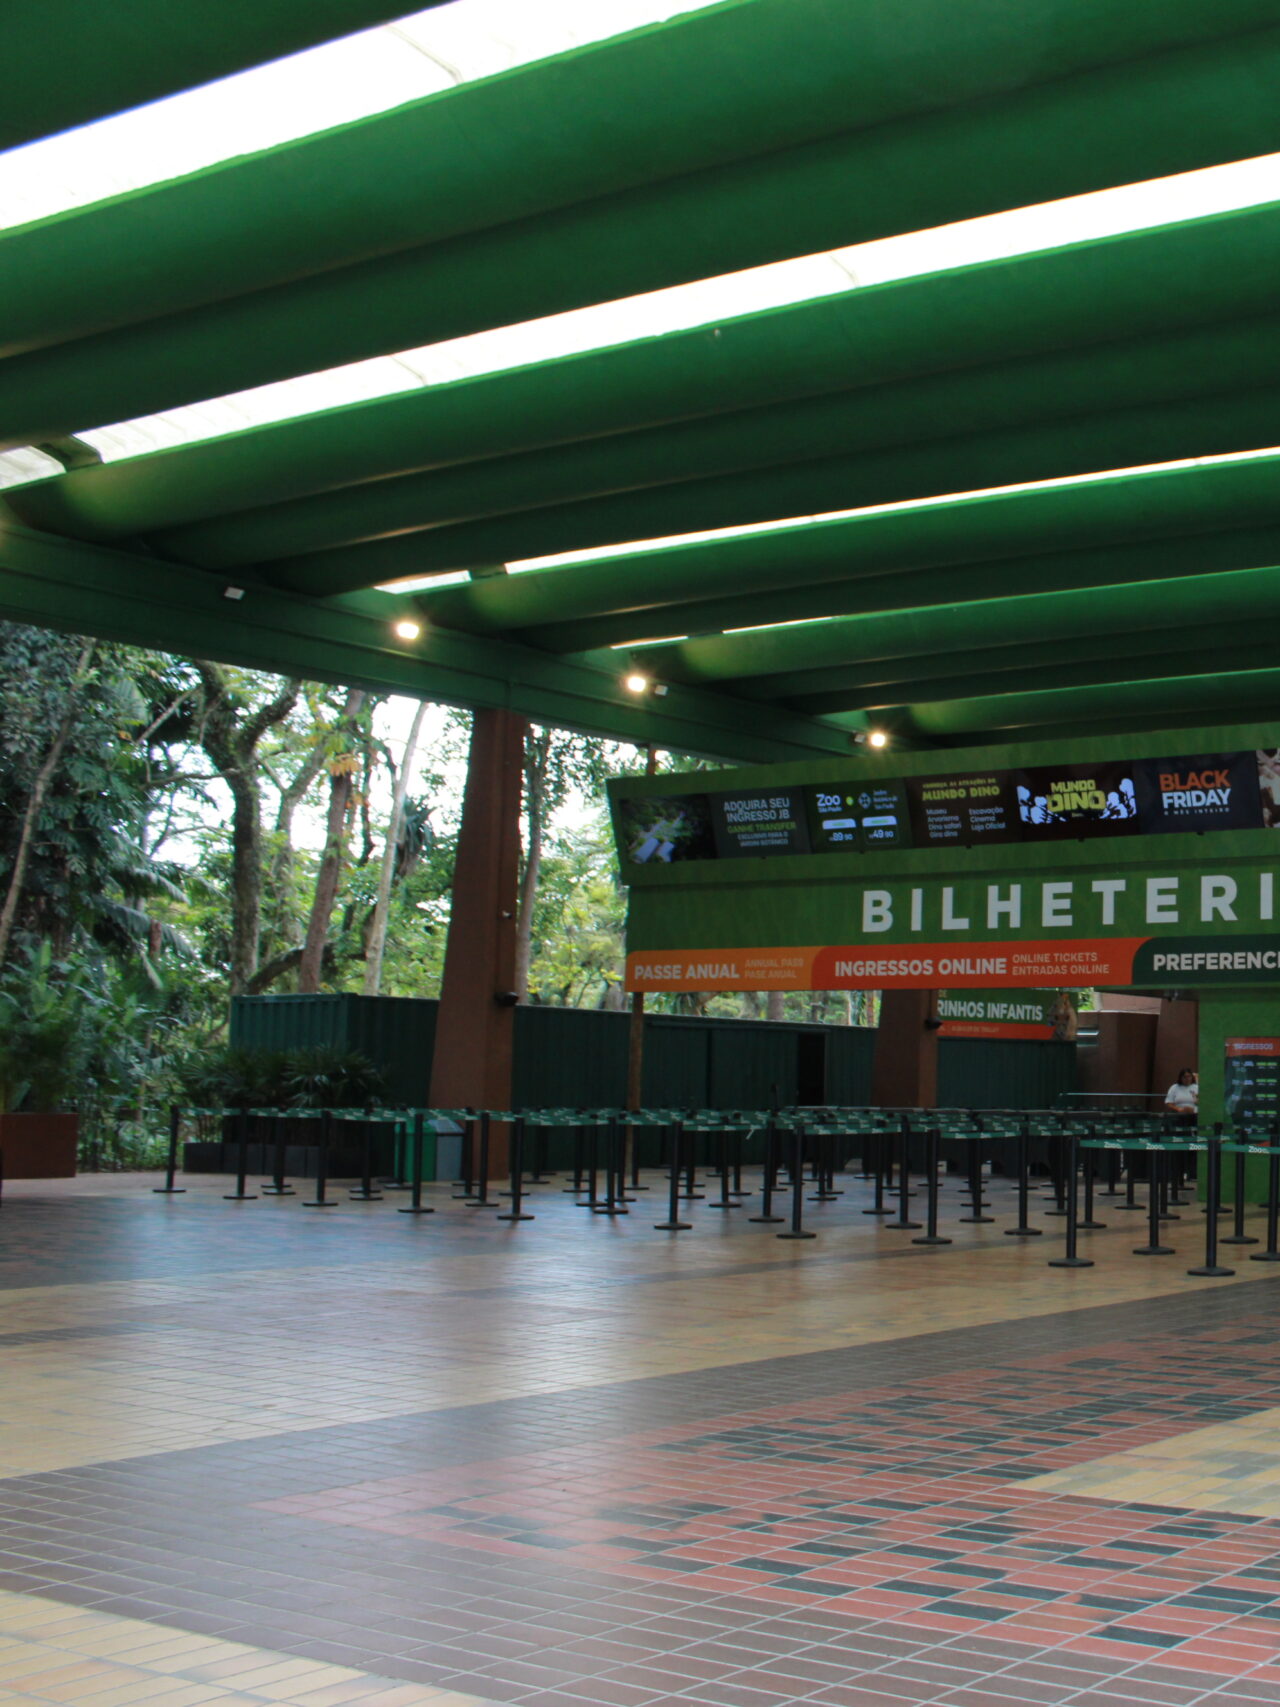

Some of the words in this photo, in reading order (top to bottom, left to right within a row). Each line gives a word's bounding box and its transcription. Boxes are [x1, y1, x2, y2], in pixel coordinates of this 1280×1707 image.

[1050, 779, 1096, 793] MUNDO
[1159, 769, 1231, 792] BLACK
[815, 793, 841, 807] Zoo
[922, 788, 967, 801] MUNDO
[970, 786, 1000, 798] DINO
[1046, 790, 1107, 813] DINO
[1162, 788, 1232, 809] FRIDAY
[723, 799, 768, 813] ADQUIRA
[769, 797, 790, 809] SEU
[726, 810, 777, 823] INGRESSO
[1012, 953, 1051, 964] ONLINE
[1053, 952, 1098, 963] TICKETS
[634, 964, 682, 980] PASSE
[684, 963, 740, 979] ANUAL
[835, 959, 934, 977] INGRESSOS
[937, 958, 1007, 975] ONLINE
[1012, 965, 1068, 976] ENTRADAS
[1071, 963, 1110, 974] ONLINE
[987, 1001, 1043, 1021] INFANTIS
